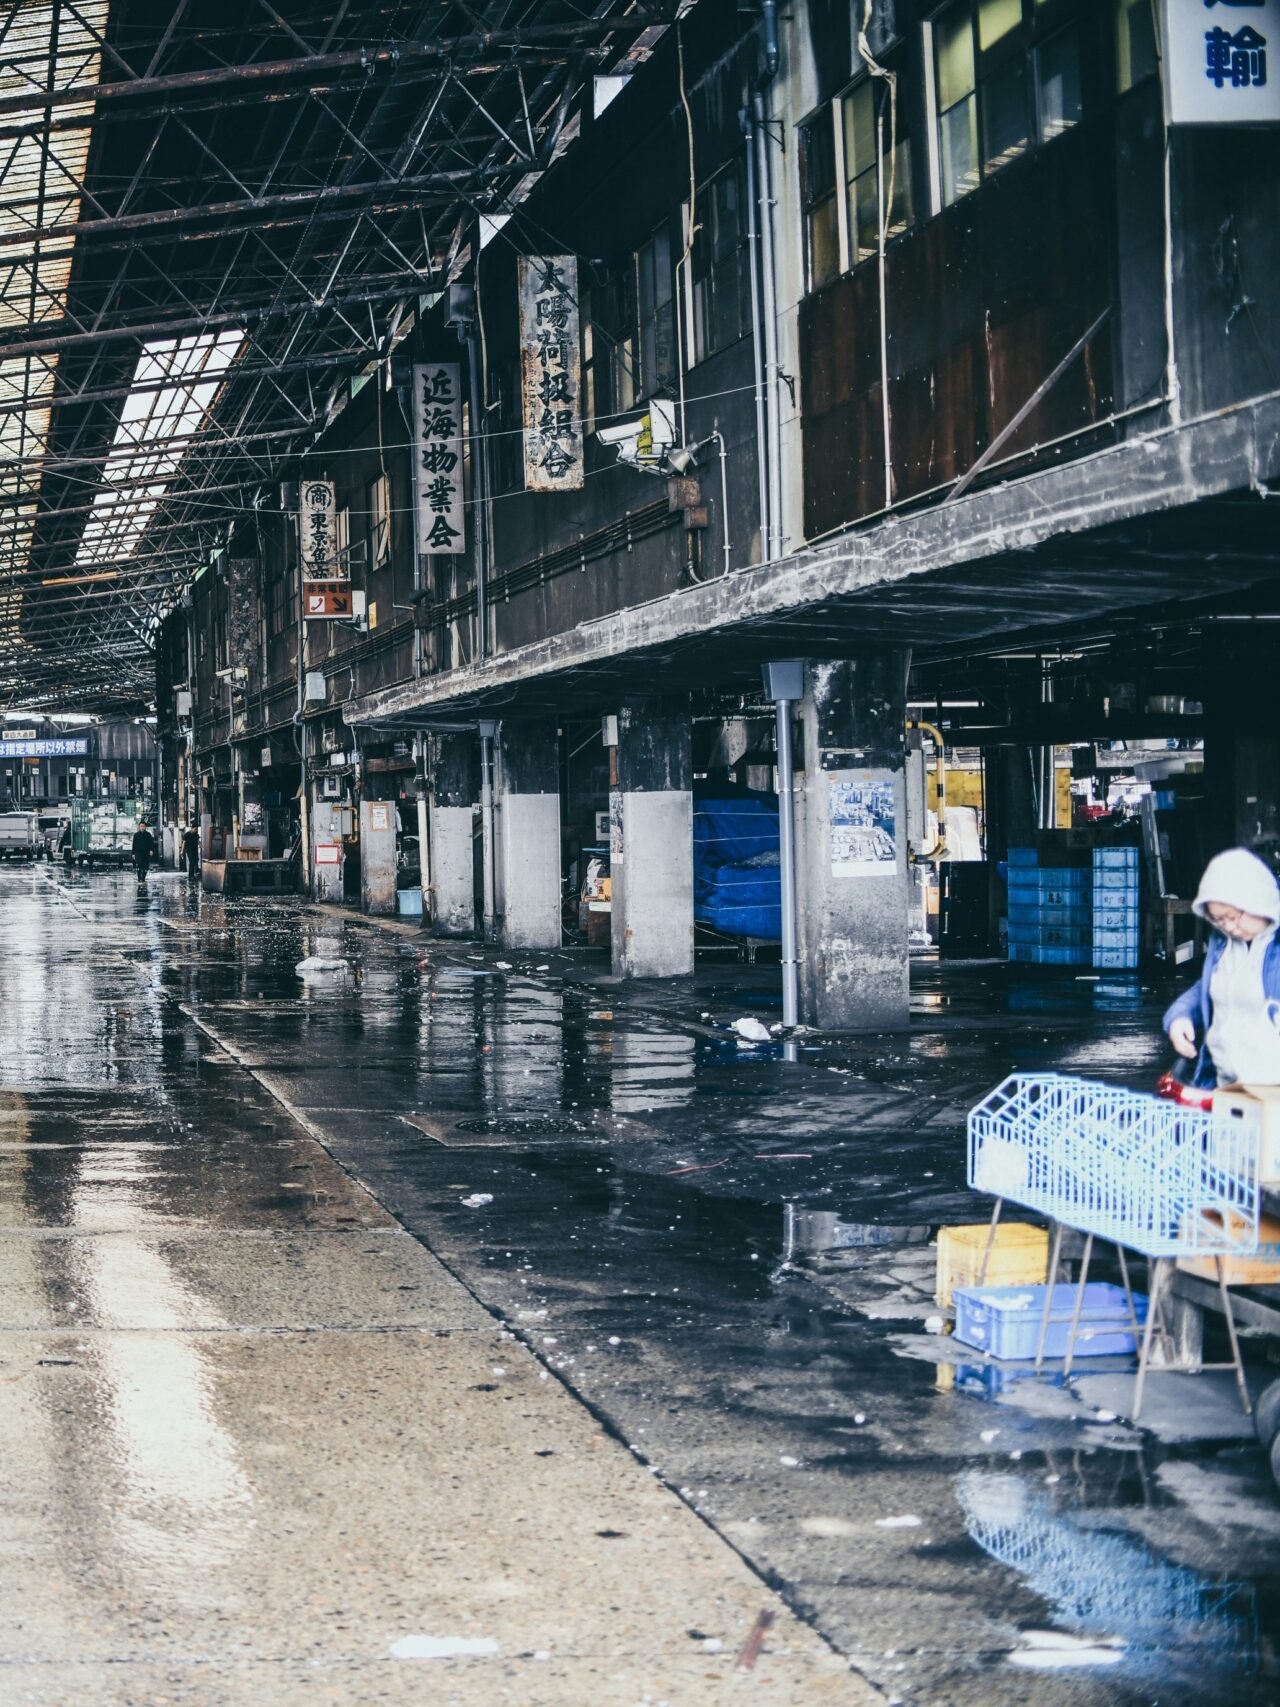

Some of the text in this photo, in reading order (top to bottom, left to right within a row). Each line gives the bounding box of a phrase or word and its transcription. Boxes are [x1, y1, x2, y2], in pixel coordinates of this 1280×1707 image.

[1203, 0, 1267, 88] 輸
[422, 369, 461, 547] 近海物業会
[534, 260, 577, 478] 太陽荷扱組合
